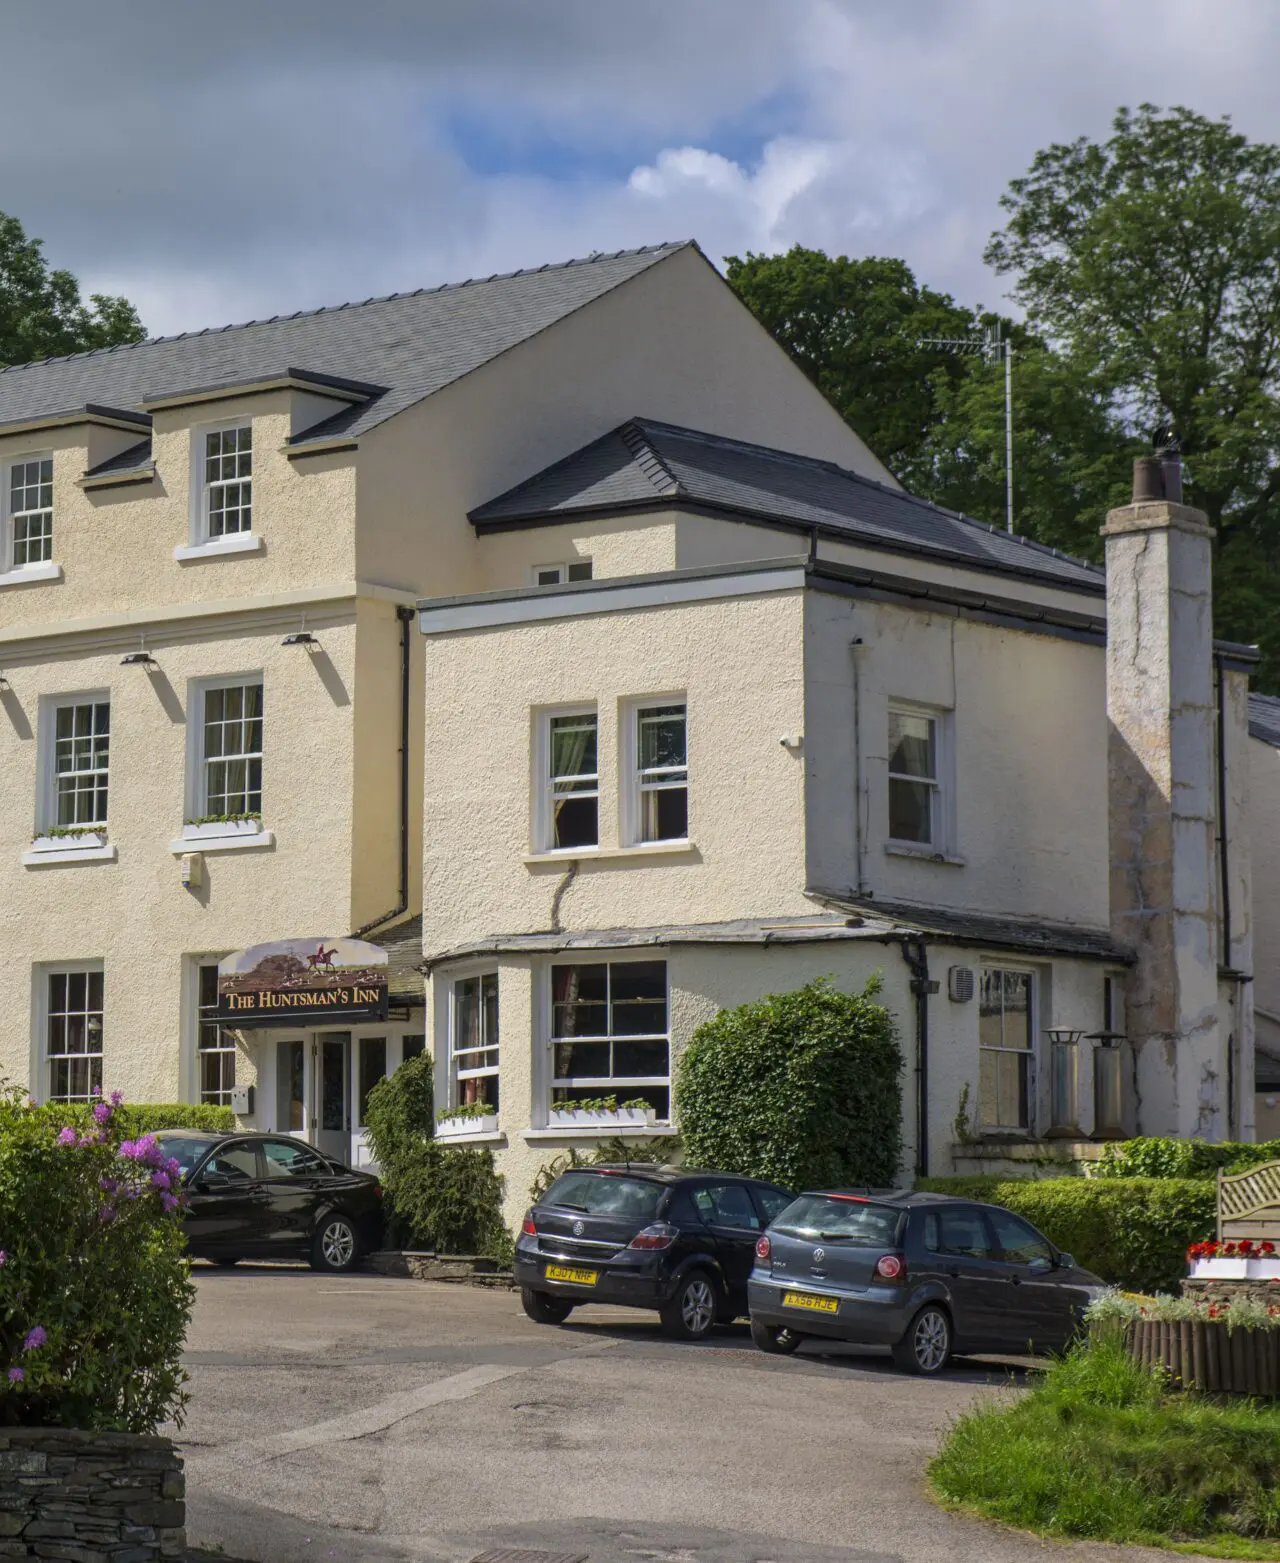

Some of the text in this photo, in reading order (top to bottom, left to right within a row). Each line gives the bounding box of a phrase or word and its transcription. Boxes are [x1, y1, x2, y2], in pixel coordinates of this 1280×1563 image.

[226, 986, 380, 1009] THE HUNTSMAN'S INN
